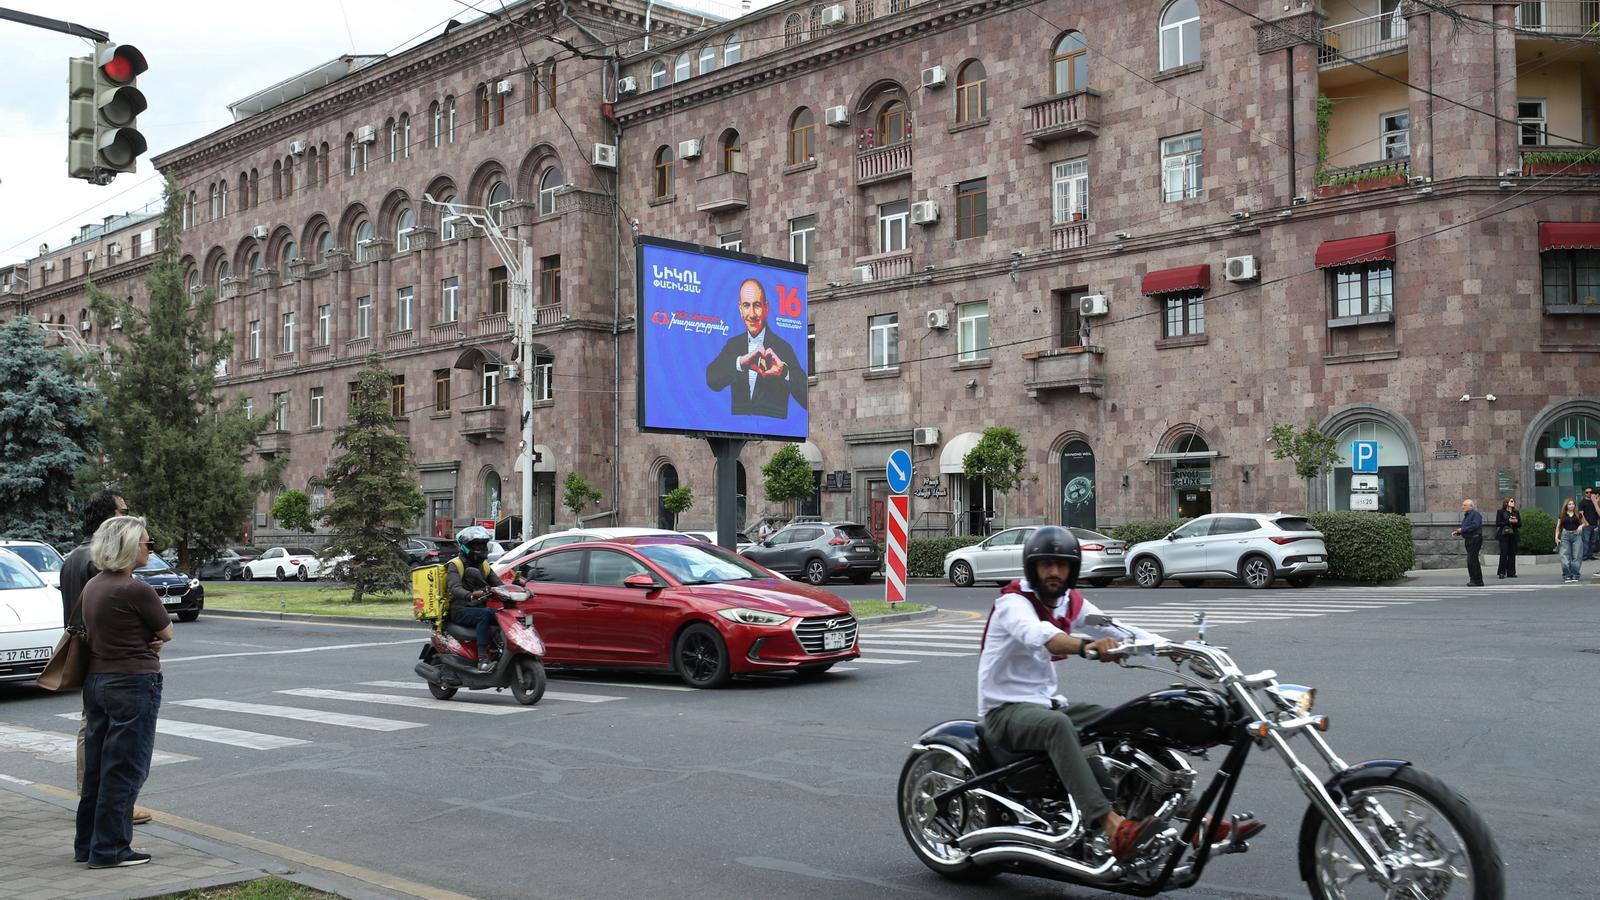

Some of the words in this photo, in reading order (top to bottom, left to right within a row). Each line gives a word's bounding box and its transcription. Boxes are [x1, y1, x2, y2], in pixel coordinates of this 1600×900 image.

[652, 264, 701, 285] ՆԻԿՈԼ
[653, 279, 702, 294] ՓԱՇԻՆՅԱՆ
[775, 285, 802, 318] 16
[1358, 443, 1373, 470] P
[7, 651, 17, 661] 17
[20, 650, 31, 659] AE
[34, 649, 49, 659] 770
